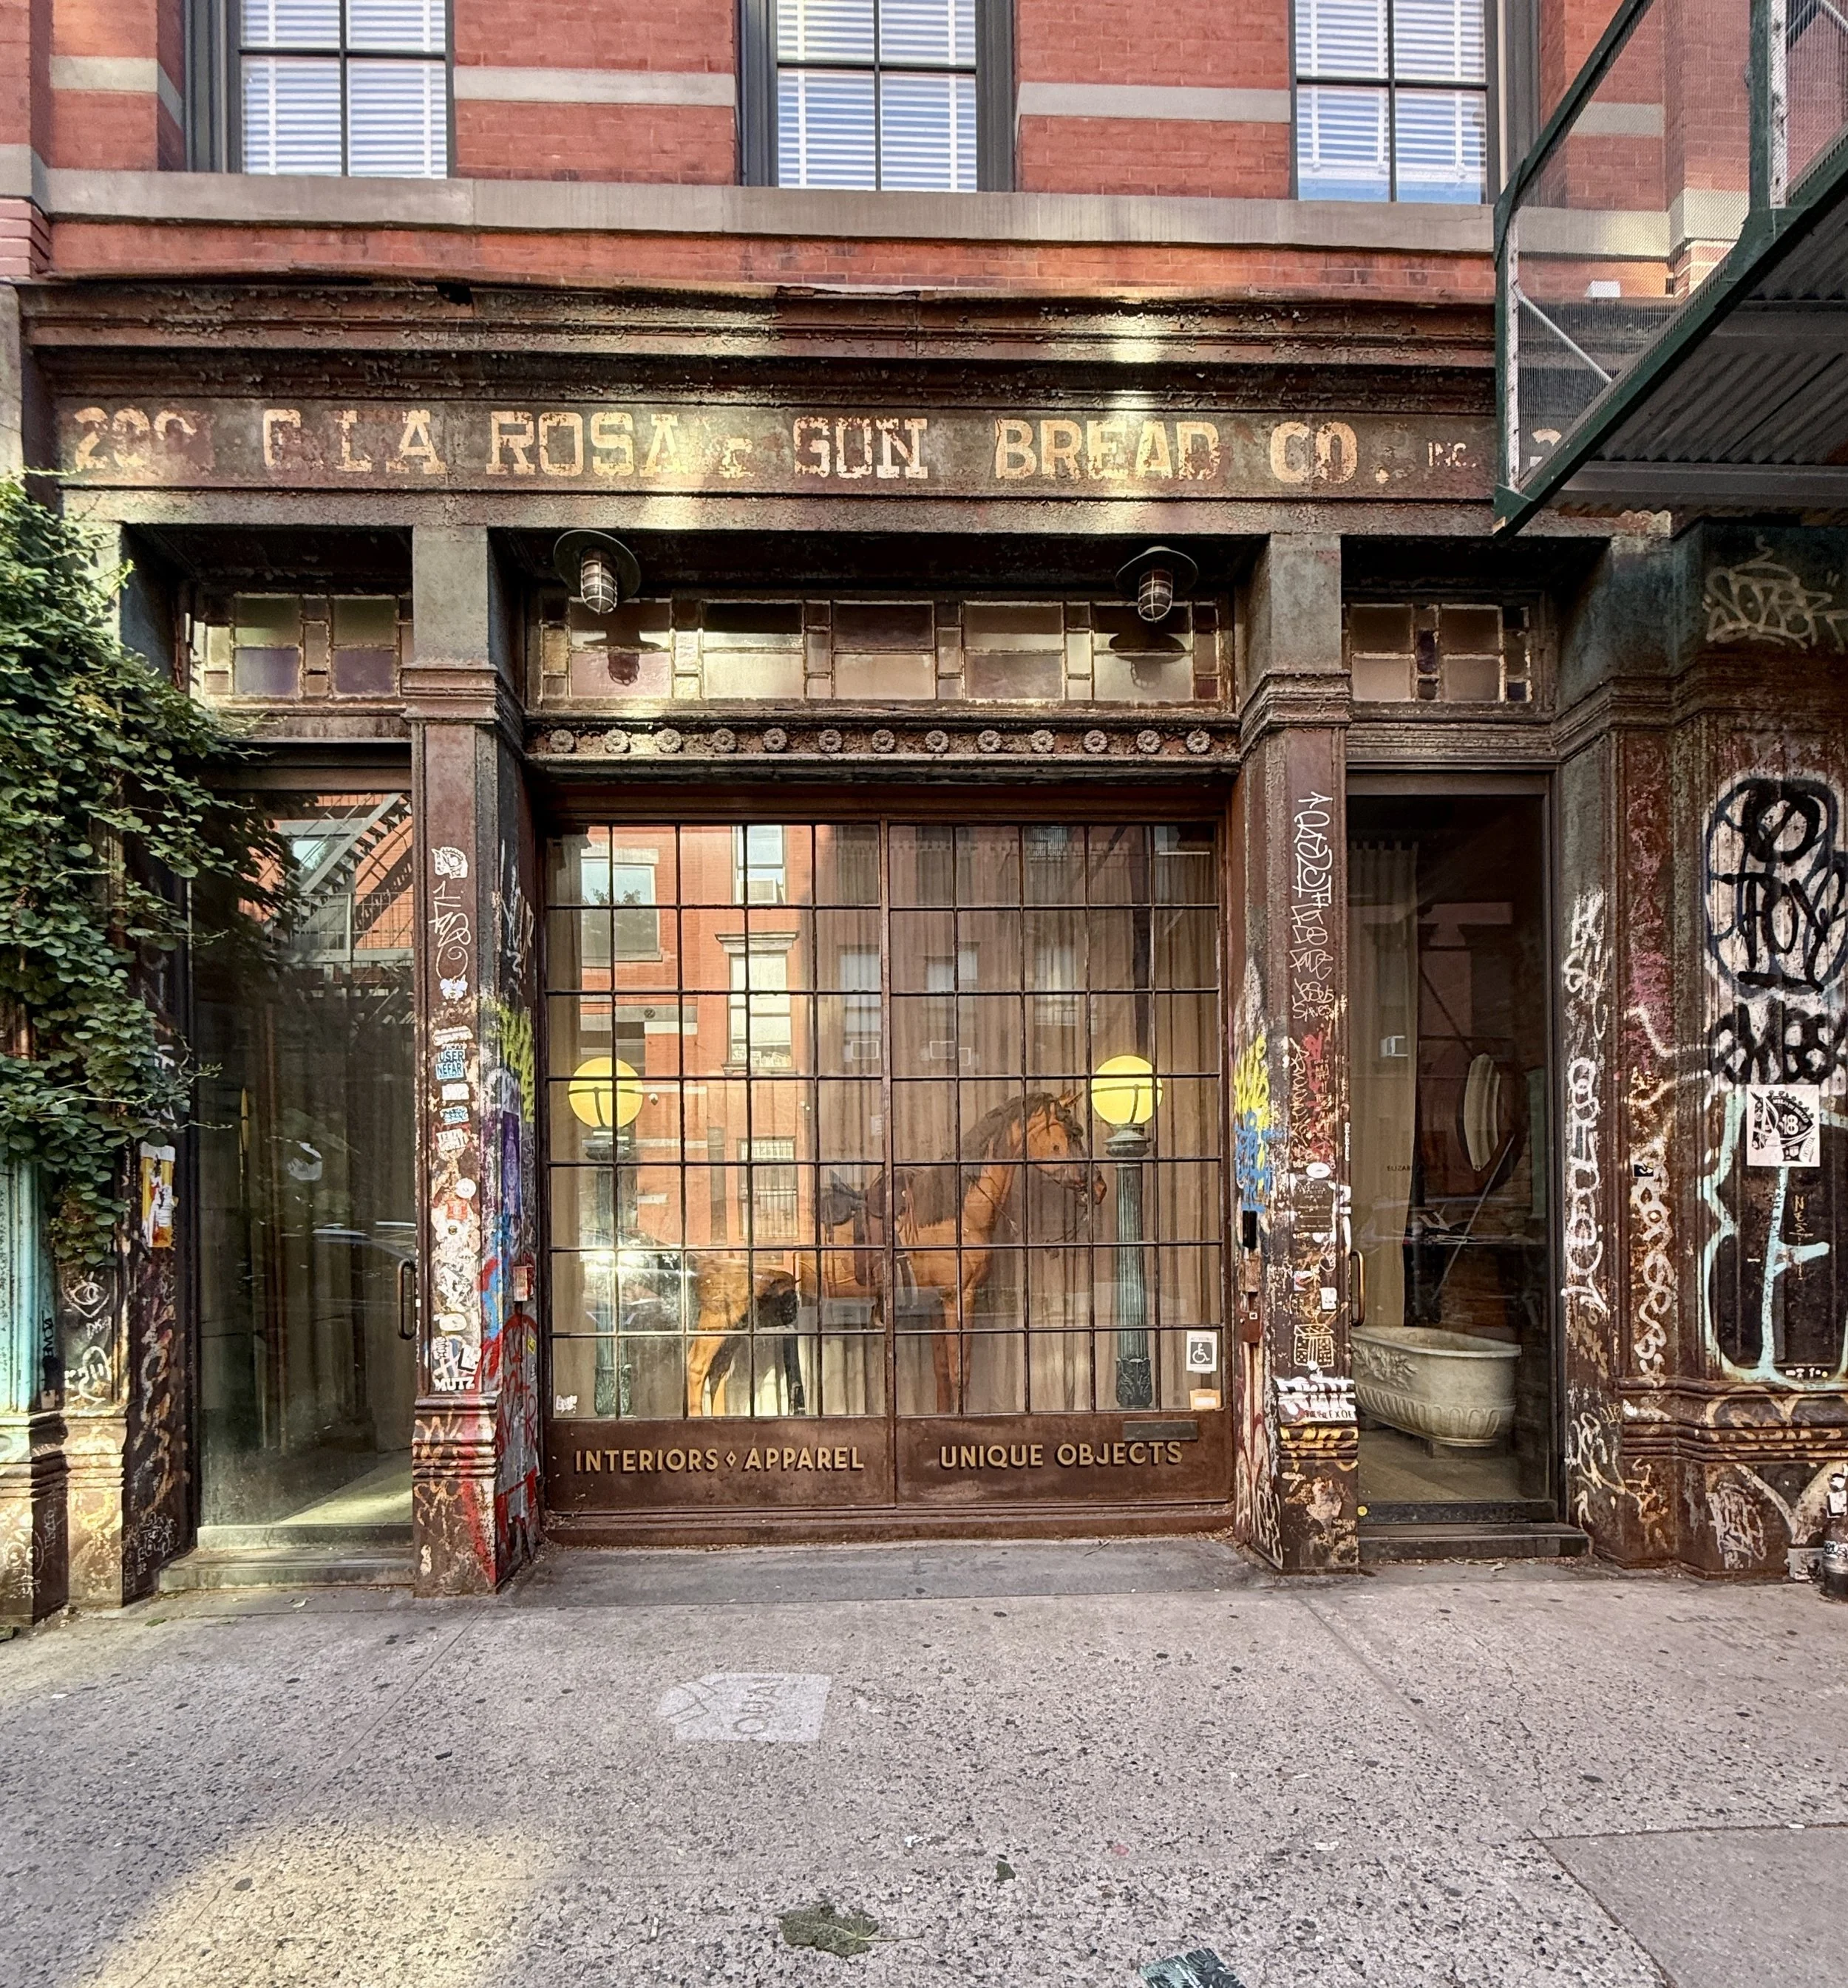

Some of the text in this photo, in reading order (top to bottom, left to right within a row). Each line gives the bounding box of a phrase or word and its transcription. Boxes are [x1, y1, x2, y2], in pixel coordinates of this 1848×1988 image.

[486, 411, 690, 479] ROSA
[995, 418, 1221, 483] BREAD
[439, 1050, 464, 1063] USER
[437, 1063, 462, 1075] NEFAR
[434, 1376, 475, 1392] MUTZ
[574, 1446, 865, 1473] INTERIORS APPAREL
[939, 1441, 1183, 1469] UNIQUE OBJECTS
